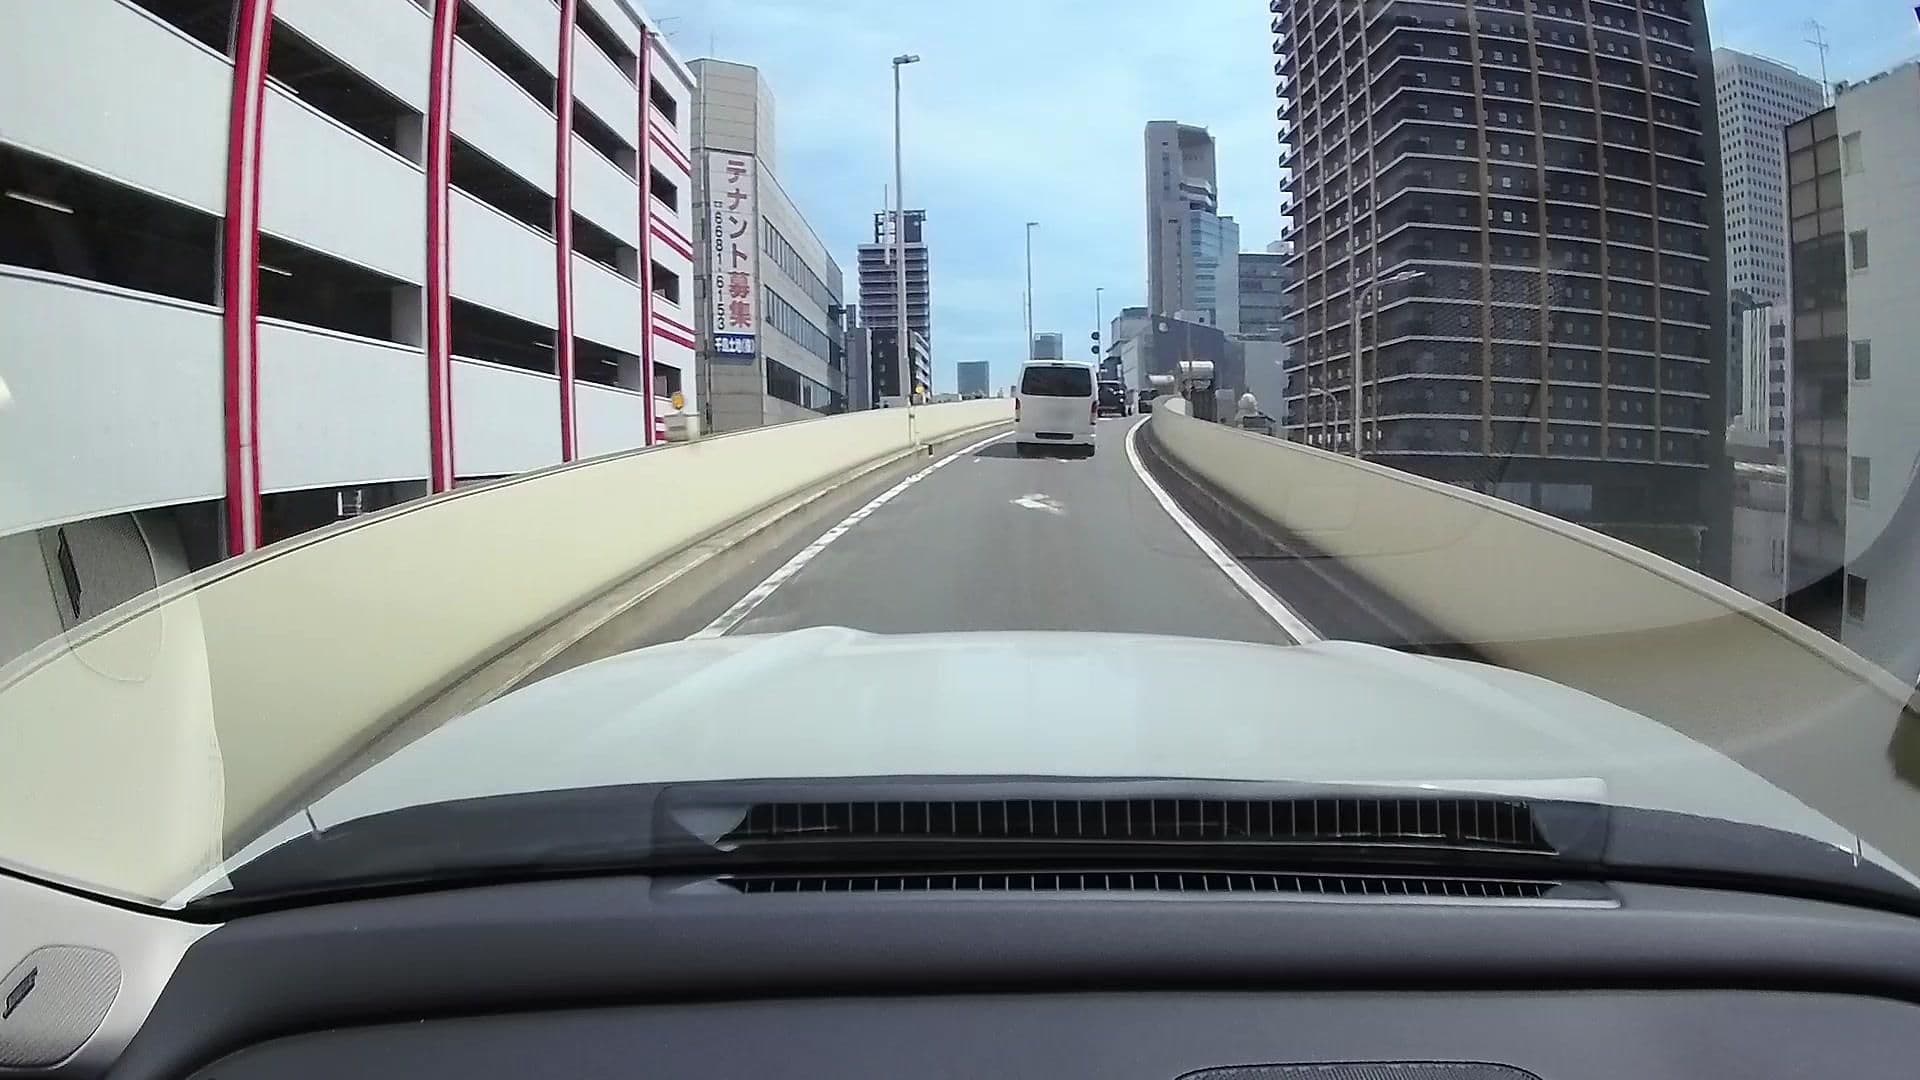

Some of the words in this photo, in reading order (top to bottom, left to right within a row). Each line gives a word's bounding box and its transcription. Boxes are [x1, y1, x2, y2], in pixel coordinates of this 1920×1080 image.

[726, 159, 752, 328] テナント募集
